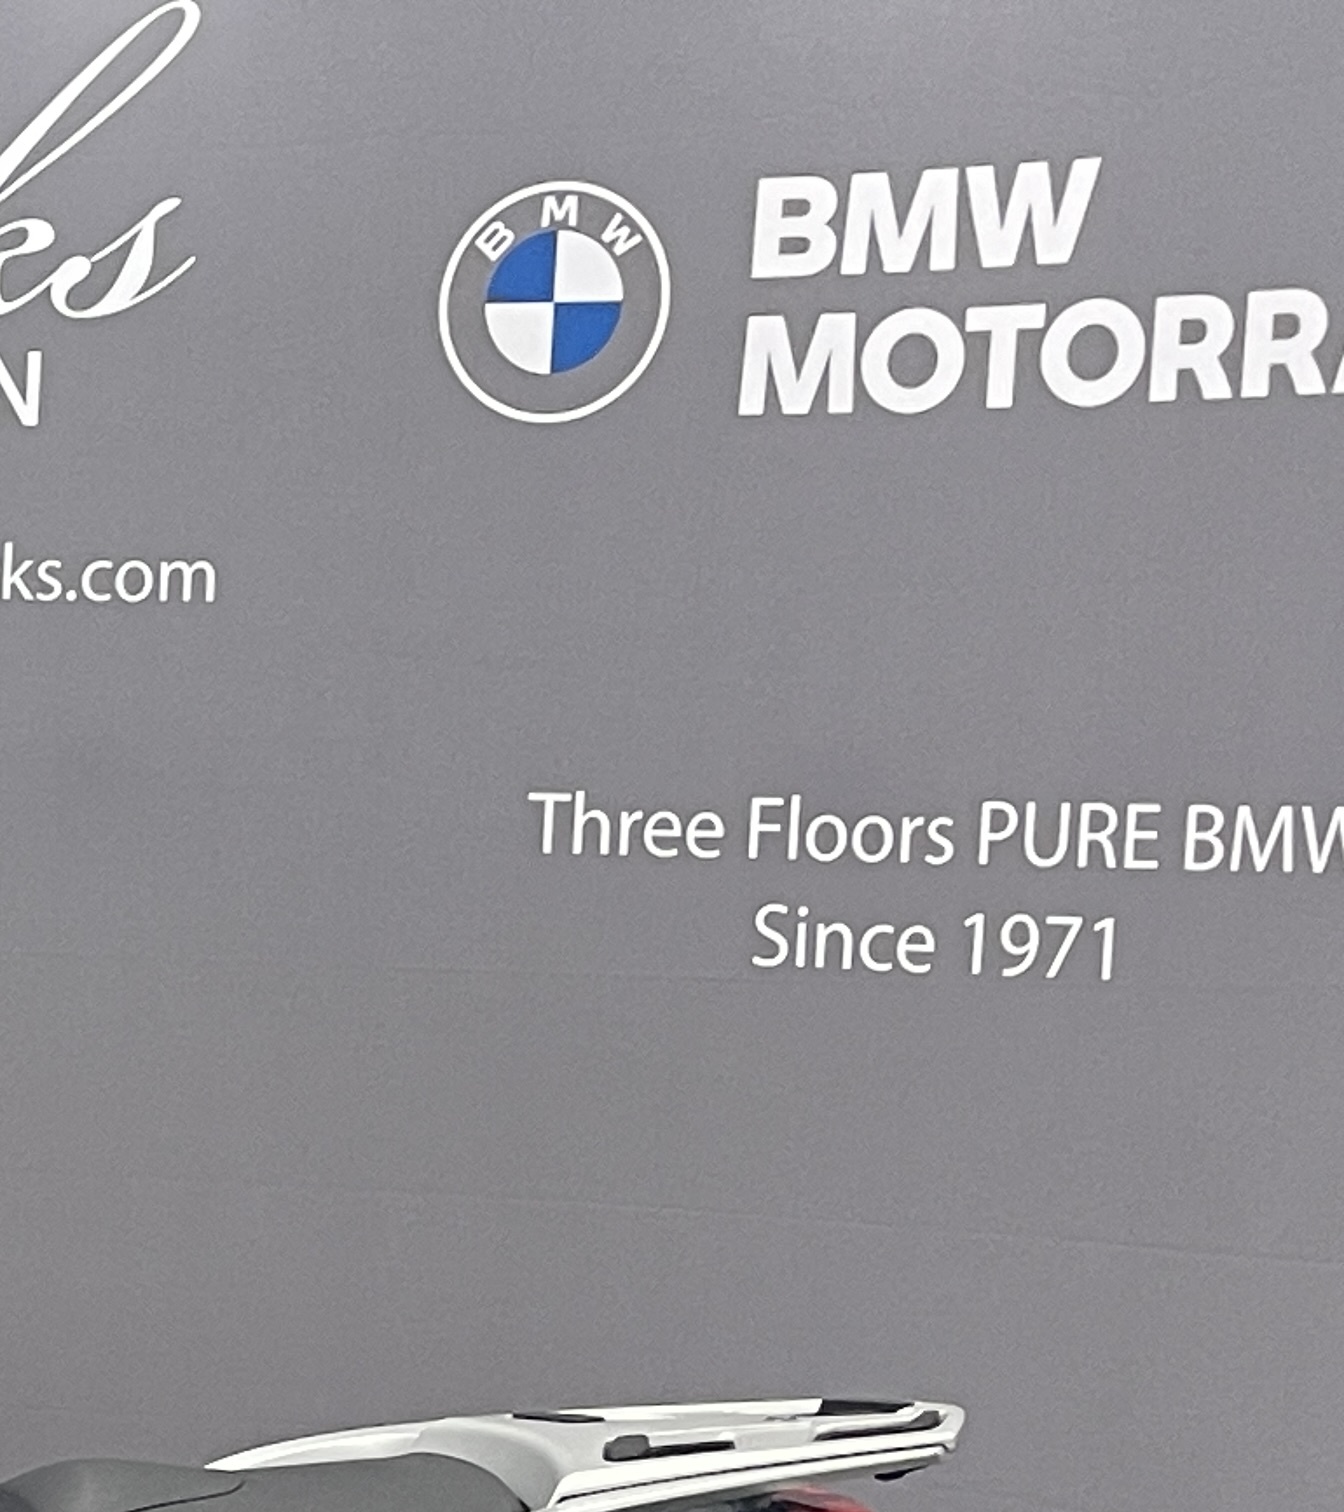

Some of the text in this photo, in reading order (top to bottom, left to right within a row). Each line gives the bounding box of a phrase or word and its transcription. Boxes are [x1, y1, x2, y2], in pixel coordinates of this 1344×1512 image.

[474, 194, 644, 263] BMW
[751, 157, 1102, 279] BMW
[739, 288, 1344, 416] MOTORR
[527, 790, 1344, 874] Three Floors PURE BMW
[751, 903, 1115, 981] Since 1971
